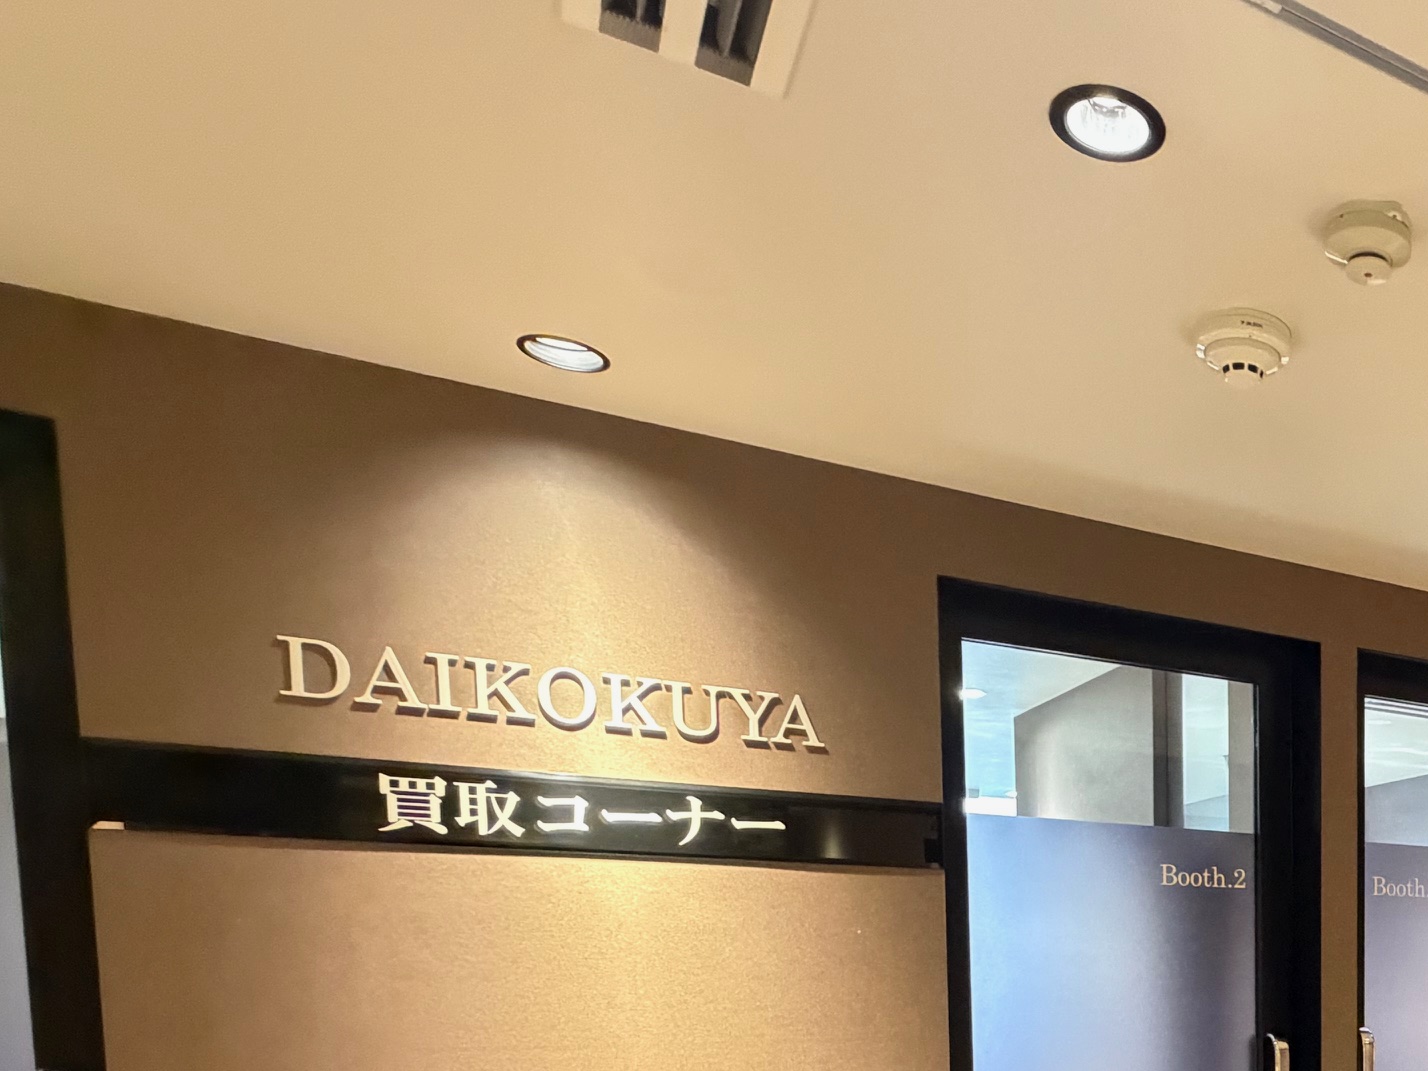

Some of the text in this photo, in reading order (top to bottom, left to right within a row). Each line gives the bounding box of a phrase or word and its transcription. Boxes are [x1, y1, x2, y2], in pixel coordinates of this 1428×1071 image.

[276, 634, 826, 750] DAIKOKUYA
[377, 772, 786, 846] 買取コーナー
[1160, 863, 1247, 889] Booth.2
